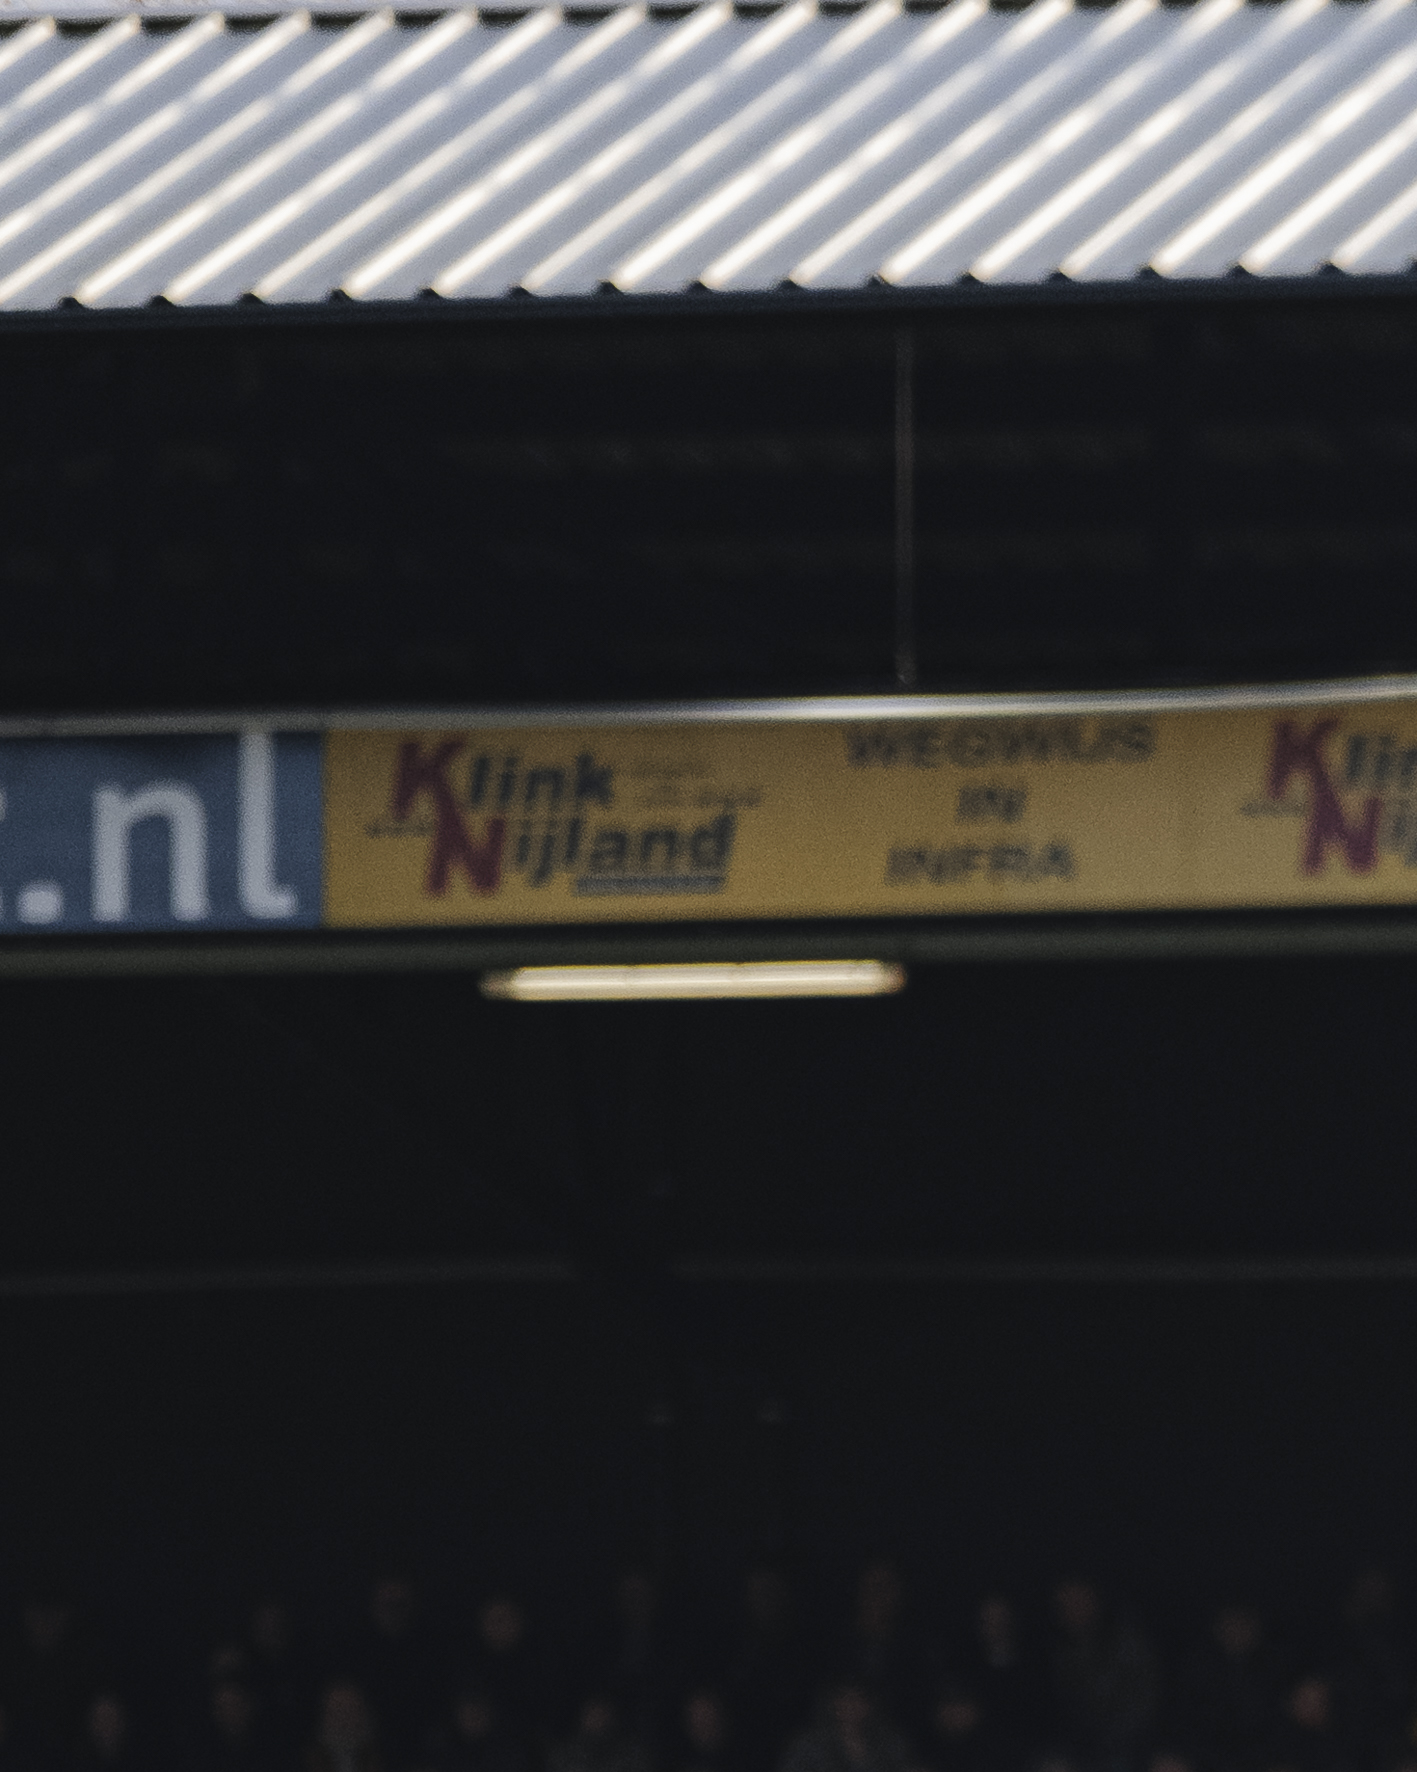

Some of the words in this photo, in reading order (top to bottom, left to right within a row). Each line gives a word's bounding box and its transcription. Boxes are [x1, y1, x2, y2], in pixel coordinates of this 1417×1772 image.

[392, 738, 615, 814] Klink
[0, 727, 298, 924] .nl
[424, 804, 737, 896] Nijland
